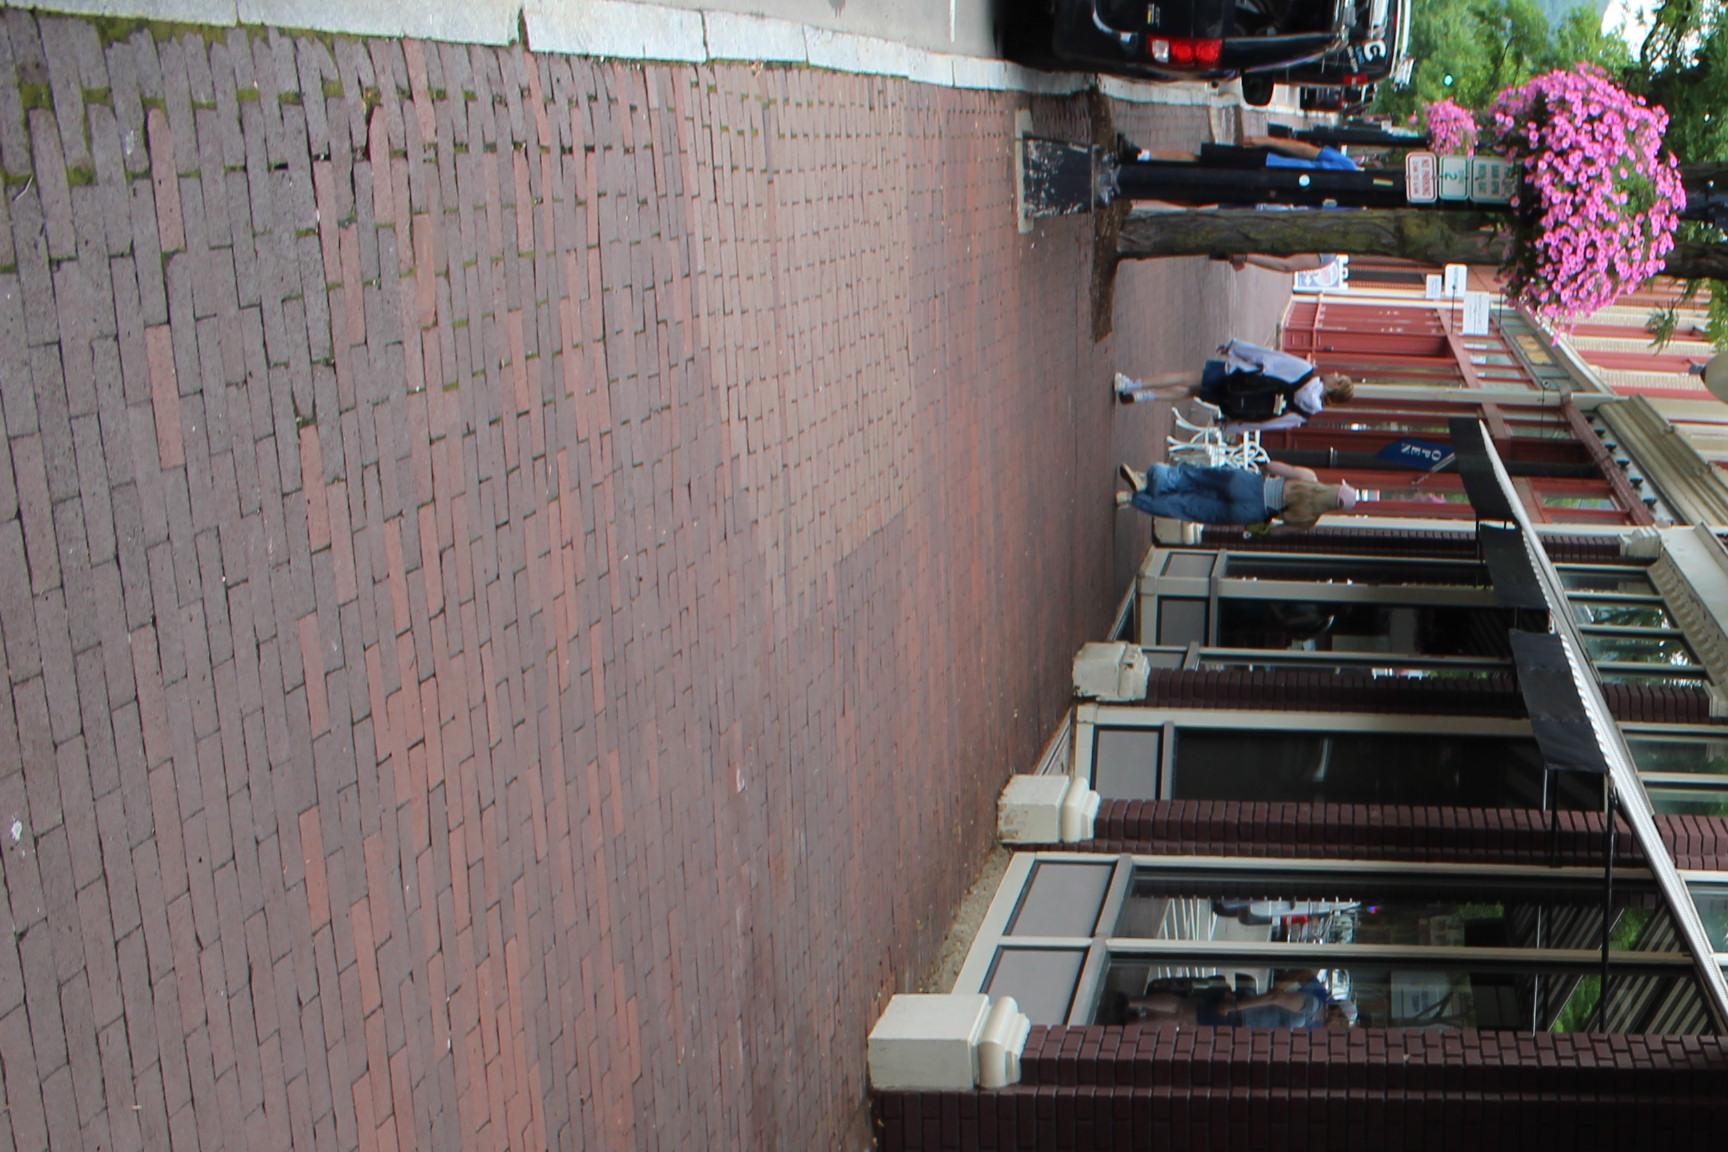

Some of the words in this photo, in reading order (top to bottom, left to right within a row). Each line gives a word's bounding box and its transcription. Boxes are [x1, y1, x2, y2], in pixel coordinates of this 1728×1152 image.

[1422, 170, 1431, 197] PARKING
[1444, 172, 1457, 182] 2
[1400, 443, 1442, 462] OPEN
